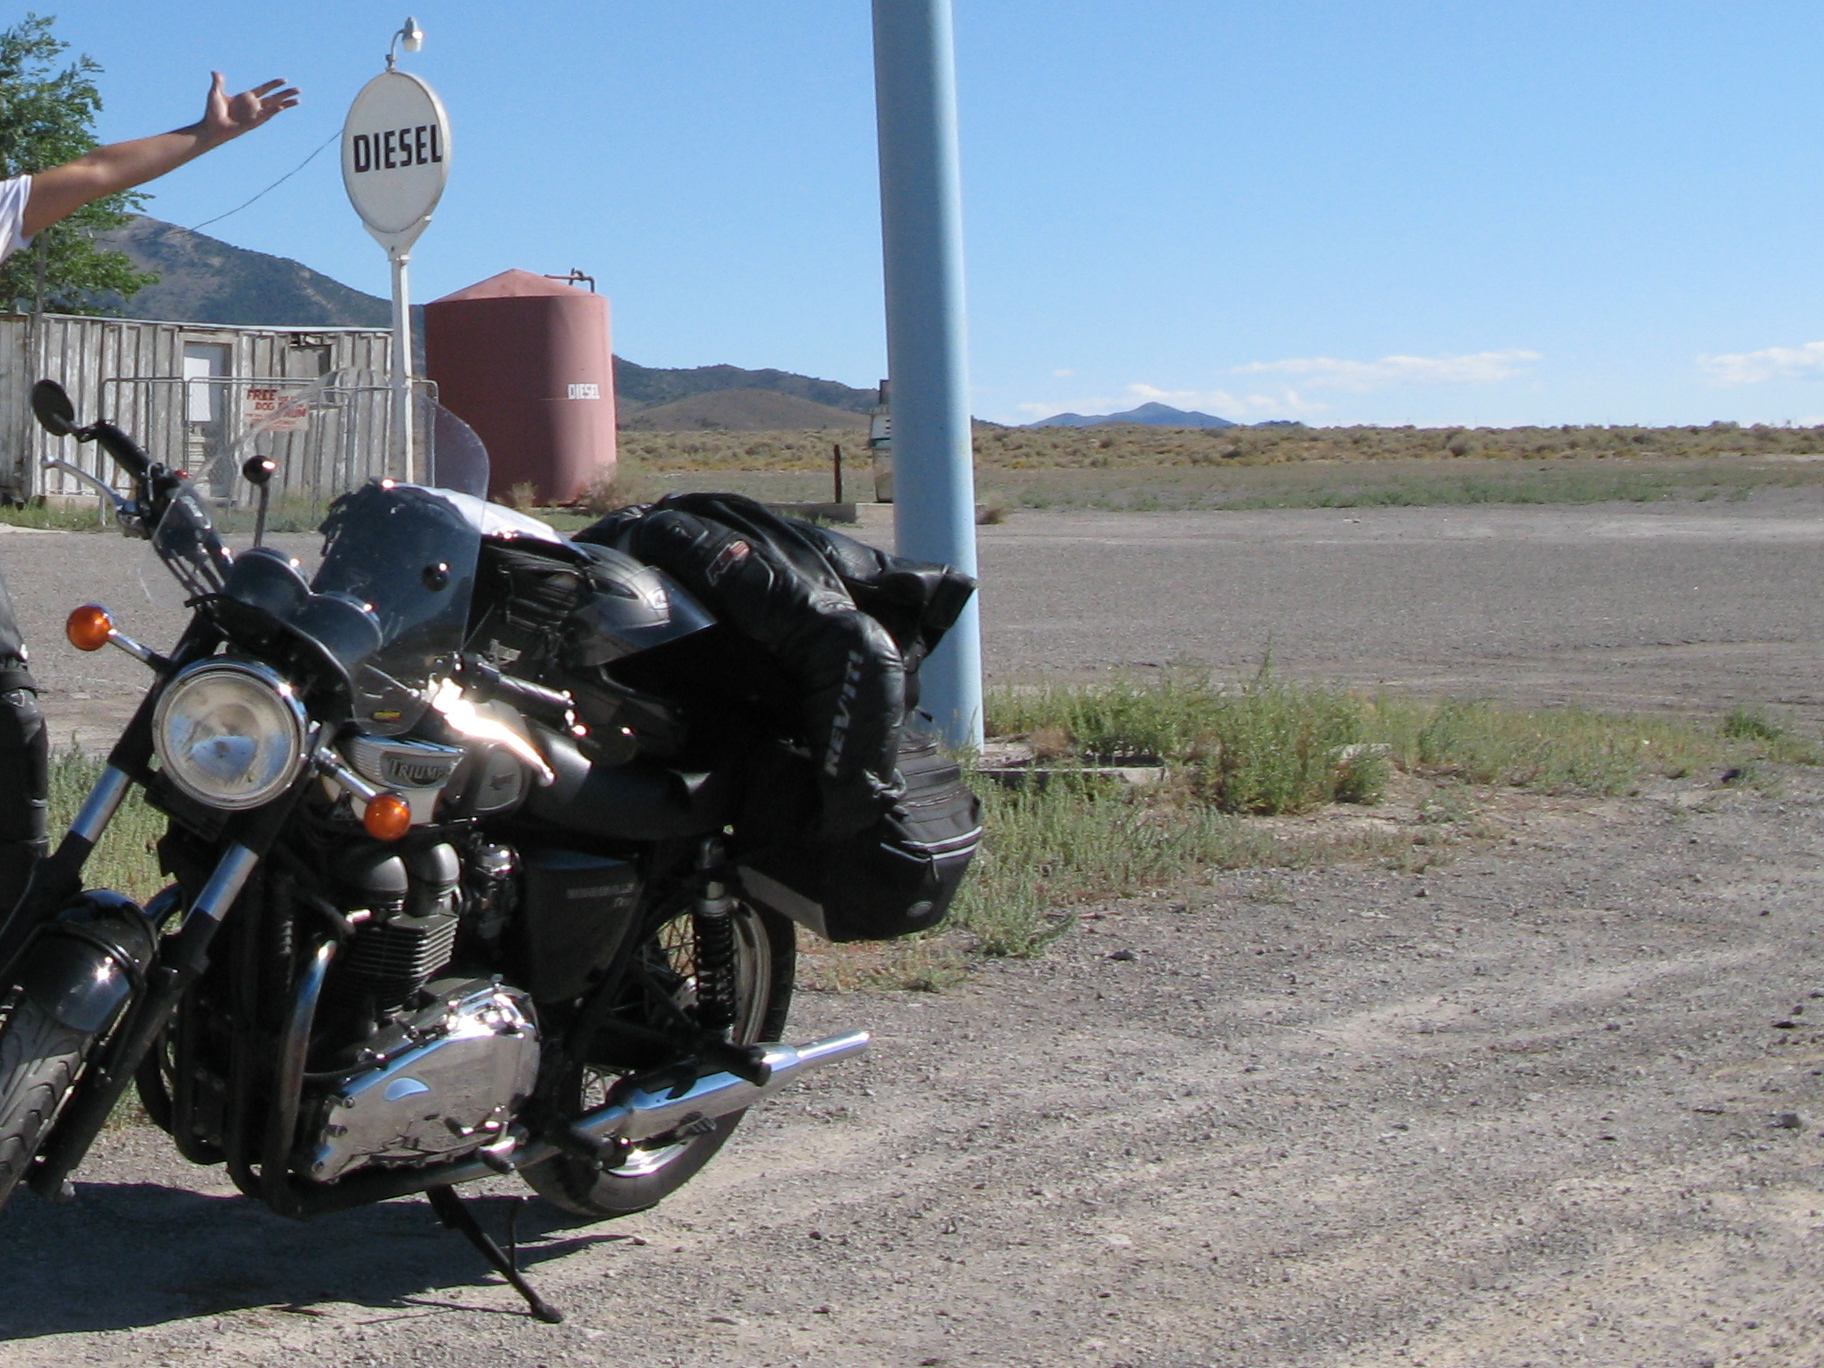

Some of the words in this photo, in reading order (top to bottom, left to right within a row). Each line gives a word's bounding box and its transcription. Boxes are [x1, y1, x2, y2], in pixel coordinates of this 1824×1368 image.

[353, 124, 442, 173] DIESEL
[247, 389, 278, 400] FREE
[568, 384, 600, 400] DIESEL
[255, 402, 275, 410] DOG
[388, 757, 453, 780] TRIUMP
